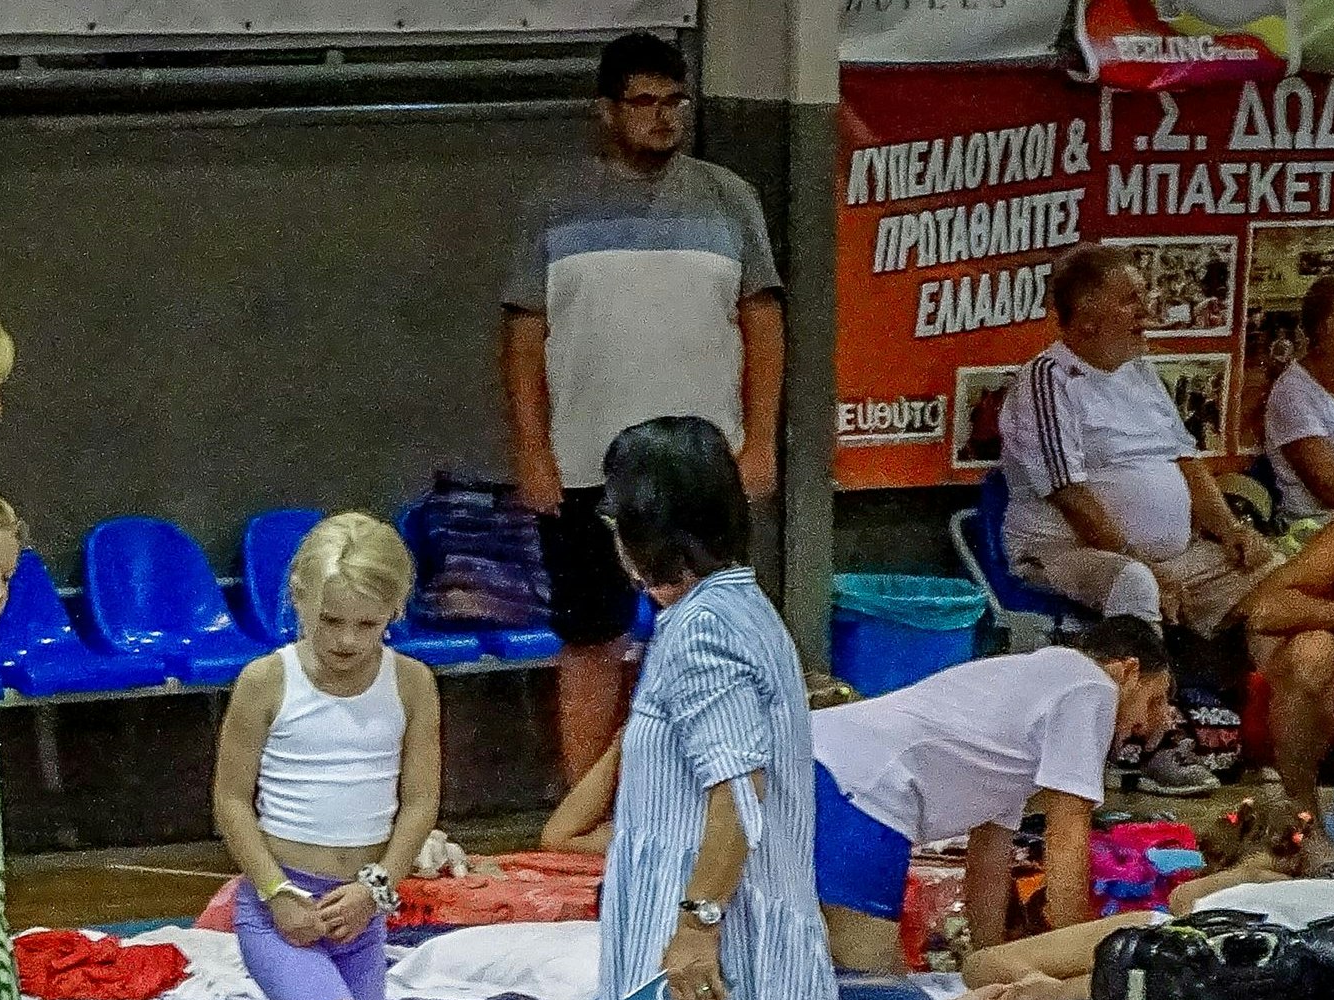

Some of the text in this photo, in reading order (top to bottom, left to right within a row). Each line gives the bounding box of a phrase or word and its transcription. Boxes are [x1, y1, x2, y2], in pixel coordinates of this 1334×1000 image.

[846, 117, 1092, 206] ΚΥΠΕΛΛΟΥΧΟΙ &
[872, 187, 1086, 274] ΠΡΩΤΑΘΛΗΤΕΣ
[914, 263, 1052, 338] ΕΛΛΑΔΟΣ
